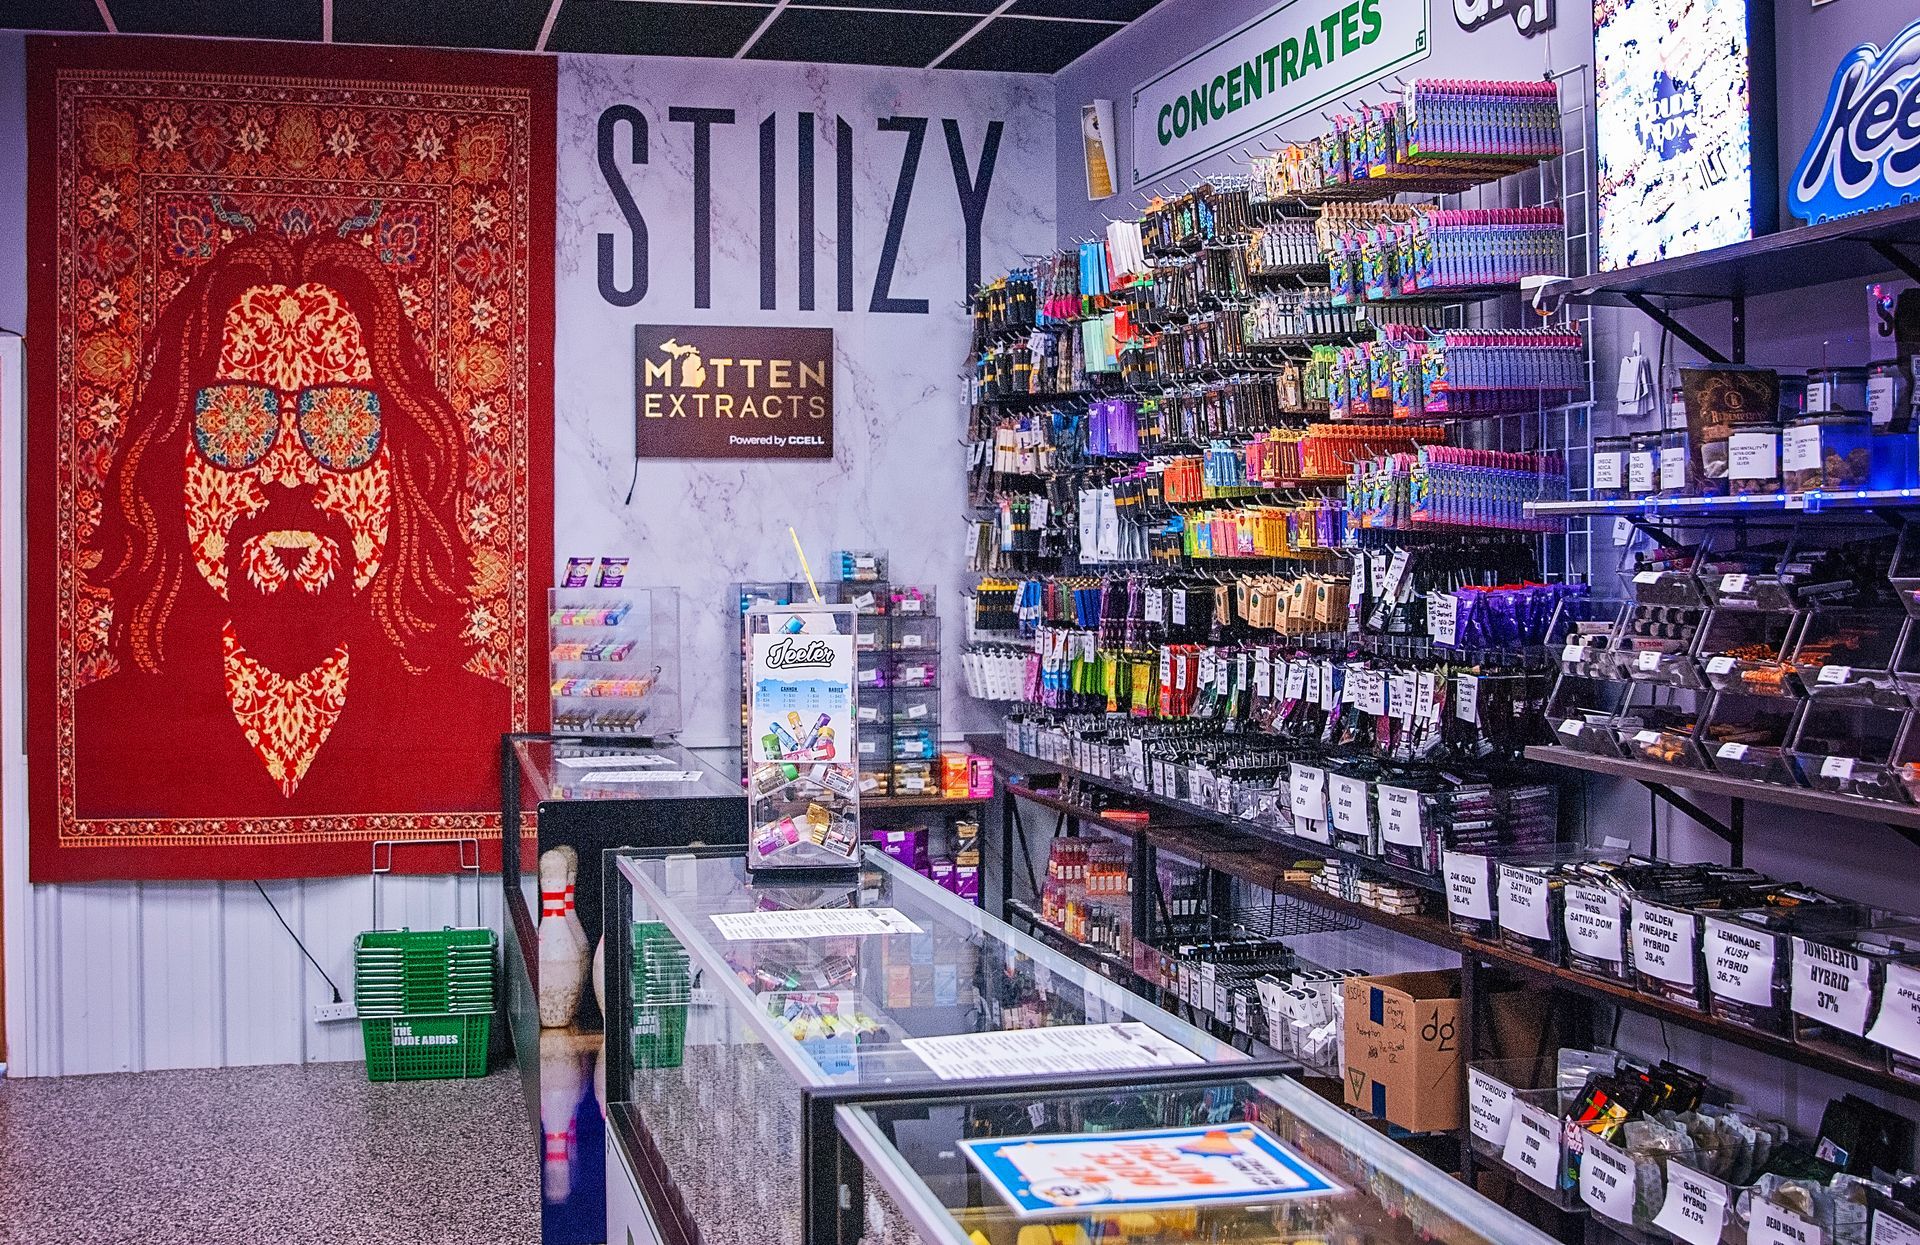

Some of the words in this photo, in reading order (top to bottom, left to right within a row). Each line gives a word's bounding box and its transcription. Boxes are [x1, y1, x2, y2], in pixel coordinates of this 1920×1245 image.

[1157, 0, 1383, 147] CONCENTRATES
[645, 394, 826, 418] EXTRACTS
[729, 435, 772, 445] Powered
[774, 435, 787, 447] by
[788, 436, 825, 445] CCELL
[766, 637, 836, 669] Jeeter
[1450, 871, 1460, 882] 24K
[1460, 873, 1476, 885] GOLD
[1503, 867, 1523, 883] LEMON
[1523, 873, 1544, 887] DROP
[1452, 884, 1472, 895] SATIVA
[1510, 881, 1533, 896] SATIVA
[1575, 889, 1607, 905] UNICORN
[1584, 904, 1601, 915] PISS
[1570, 912, 1594, 927] SATIVA
[1595, 916, 1612, 931] DOM
[1644, 911, 1674, 928] GOLDEN
[1578, 926, 1599, 940] 38.6%
[1638, 922, 1678, 943] PINEAPPLE
[1717, 929, 1761, 951] LEMONADE
[1642, 937, 1670, 954] HYBRID
[1724, 945, 1750, 961] KUSH
[1716, 956, 1749, 974] HYBRID
[1716, 970, 1741, 987] 36.7%
[1810, 965, 1850, 993] HYBRID
[1817, 991, 1840, 1014] 37%
[393, 1026, 412, 1036] THE
[394, 1036, 420, 1046] DUDE
[421, 1034, 458, 1045] ABIDES
[1474, 1077, 1508, 1100] NOTORIOUS
[1481, 1094, 1493, 1107] THC
[1683, 1181, 1707, 1200] G-ROLL
[1682, 1192, 1707, 1213] HYBRID
[1681, 1206, 1704, 1225] 18.13%
[1766, 1215, 1781, 1232] DEAD
[1782, 1222, 1797, 1239] HEAD
